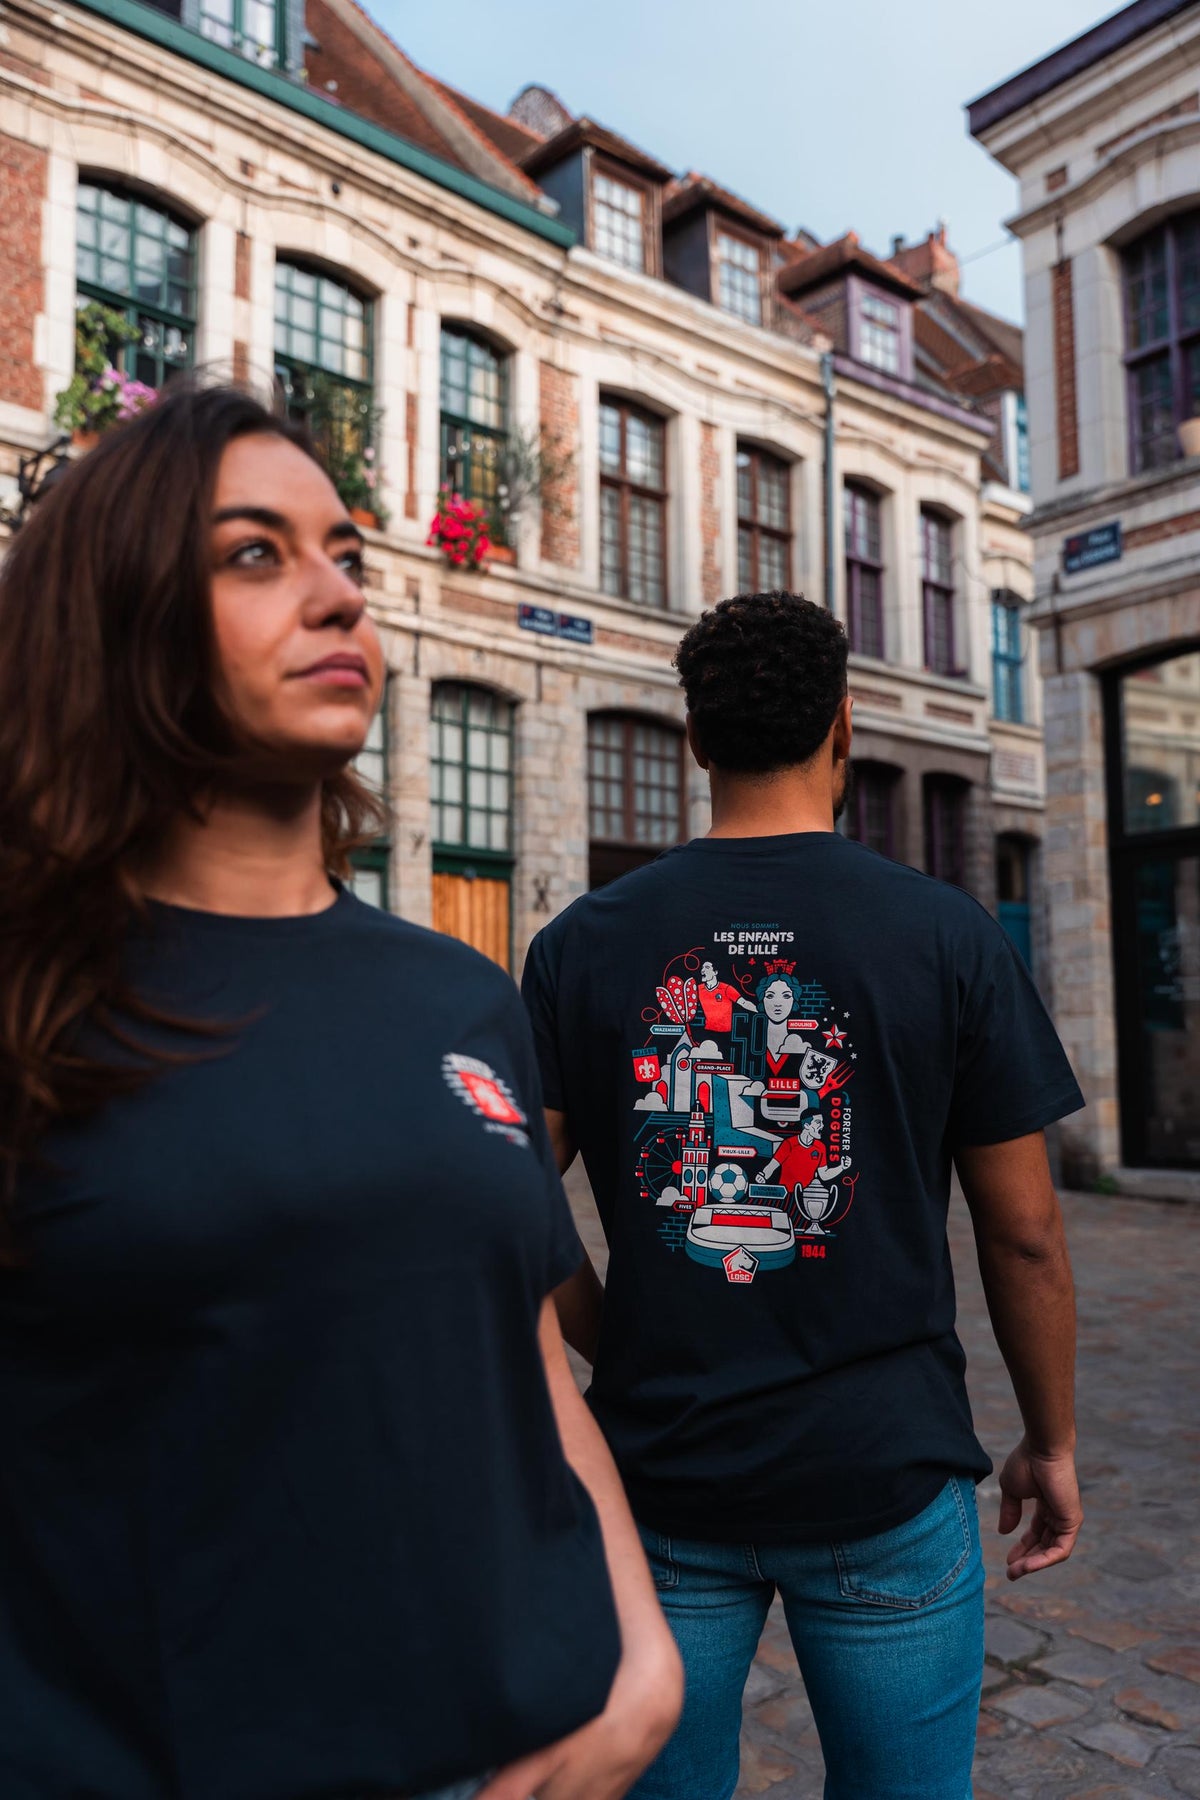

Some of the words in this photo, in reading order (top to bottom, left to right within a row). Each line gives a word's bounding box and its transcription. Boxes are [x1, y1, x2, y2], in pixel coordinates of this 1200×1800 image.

[713, 931, 735, 942] LES
[738, 931, 795, 942] ENFANTS
[728, 944, 745, 955] DE
[747, 944, 778, 955] LILLE
[770, 1080, 798, 1089] LILLE
[829, 1097, 842, 1162] DOGUES
[842, 1107, 852, 1151] FOREVER
[801, 1244, 826, 1259] 1944
[730, 1273, 750, 1281] LOSC
